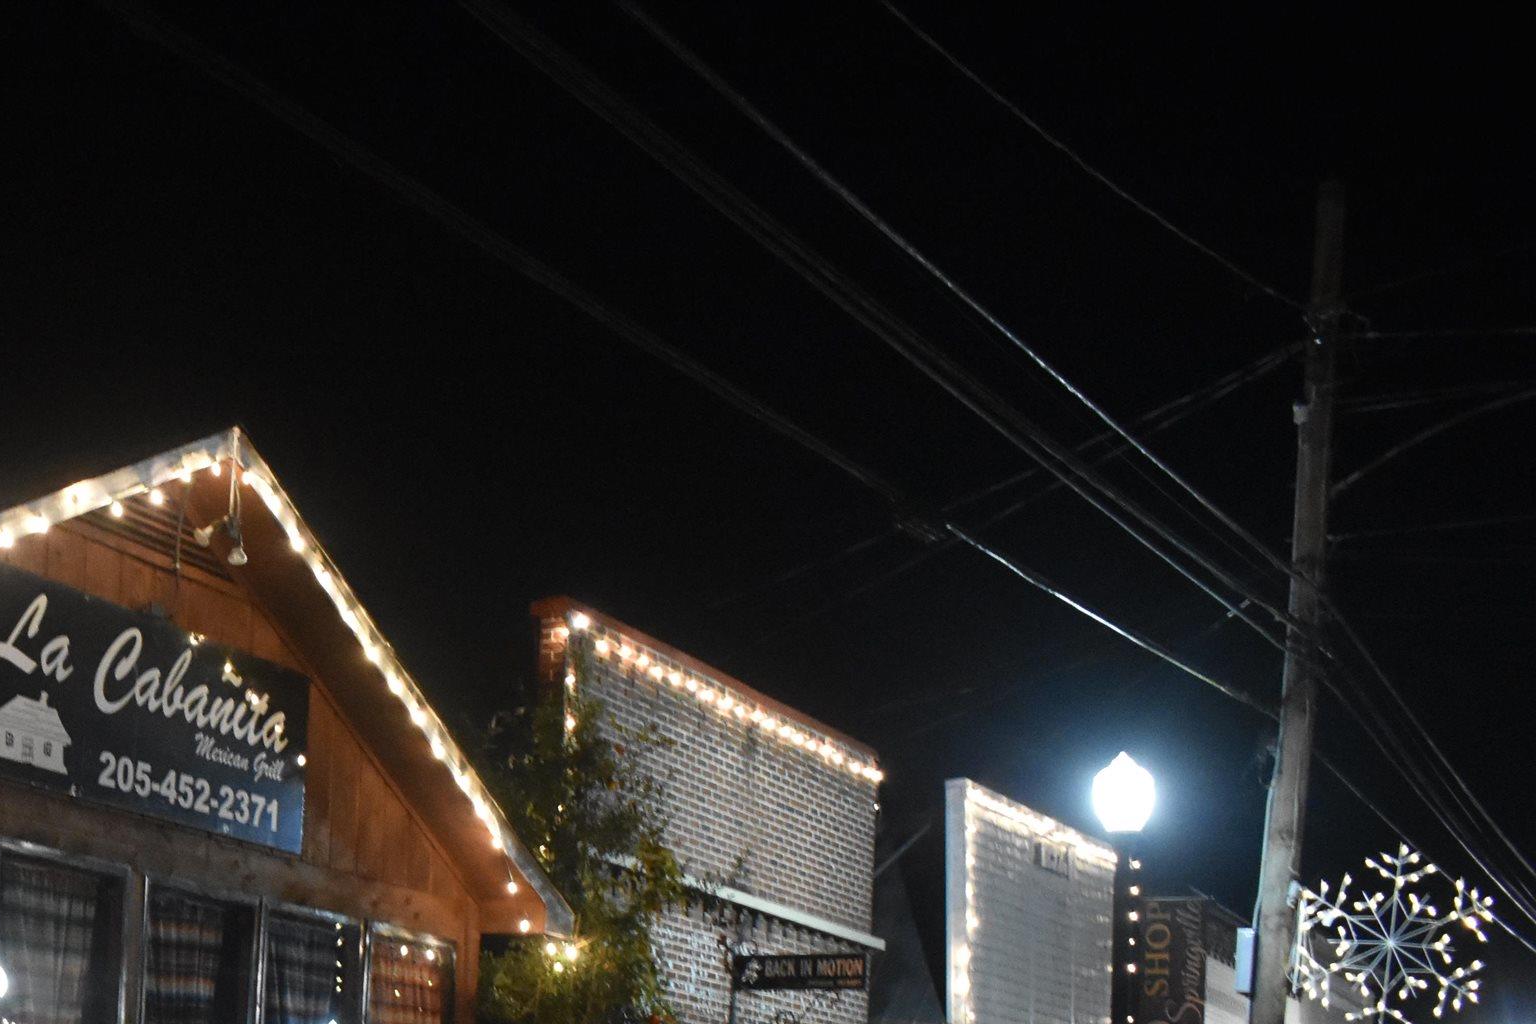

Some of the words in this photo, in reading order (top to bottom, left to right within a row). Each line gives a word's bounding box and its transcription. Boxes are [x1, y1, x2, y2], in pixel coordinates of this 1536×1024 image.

[194, 732, 249, 771] Mexican
[254, 752, 284, 783] Grill
[98, 752, 278, 832] 205-452-2371
[765, 958, 796, 978] BACK
[800, 958, 813, 977] IN
[817, 957, 864, 977] MOTION
[1144, 902, 1171, 996] SHOP
